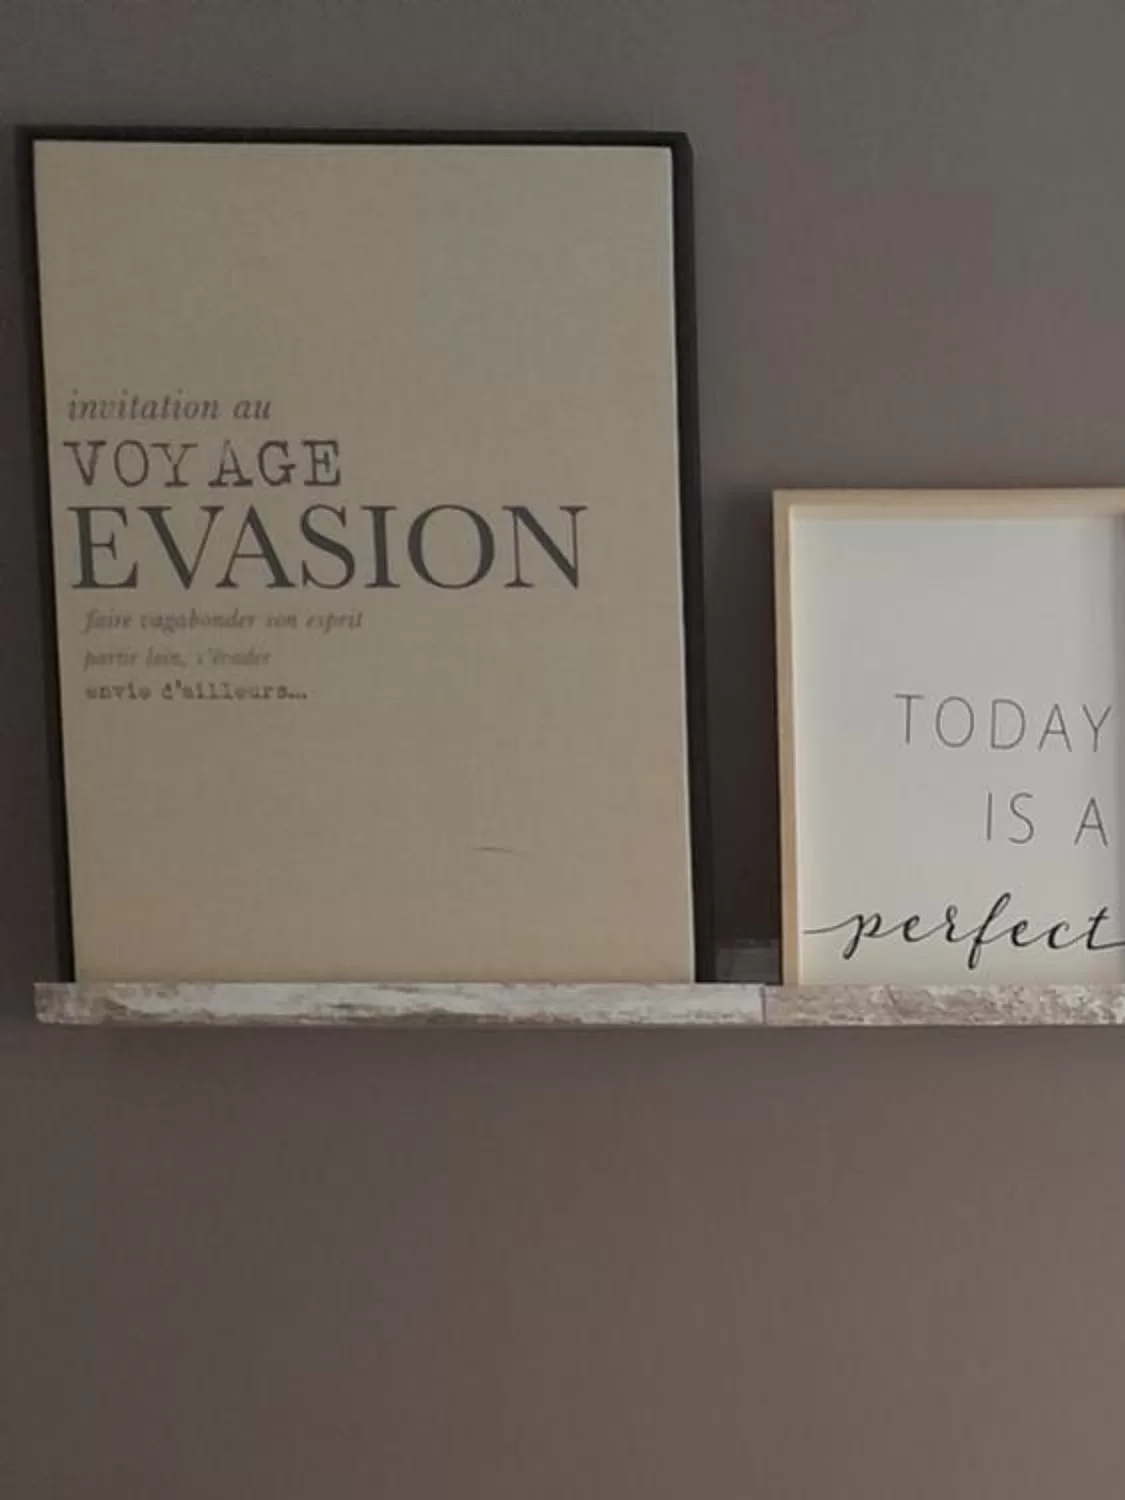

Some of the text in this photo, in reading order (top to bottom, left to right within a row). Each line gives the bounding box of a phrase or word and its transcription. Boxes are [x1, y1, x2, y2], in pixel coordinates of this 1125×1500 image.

[68, 388, 272, 421] invitation au
[62, 439, 342, 488] VOYAGE
[67, 503, 588, 591] EVASION
[139, 607, 256, 634] vagabonder
[305, 609, 364, 636] esprit
[84, 682, 152, 700] envie
[894, 692, 1113, 753] TODAY
[985, 792, 1109, 847] IS A
